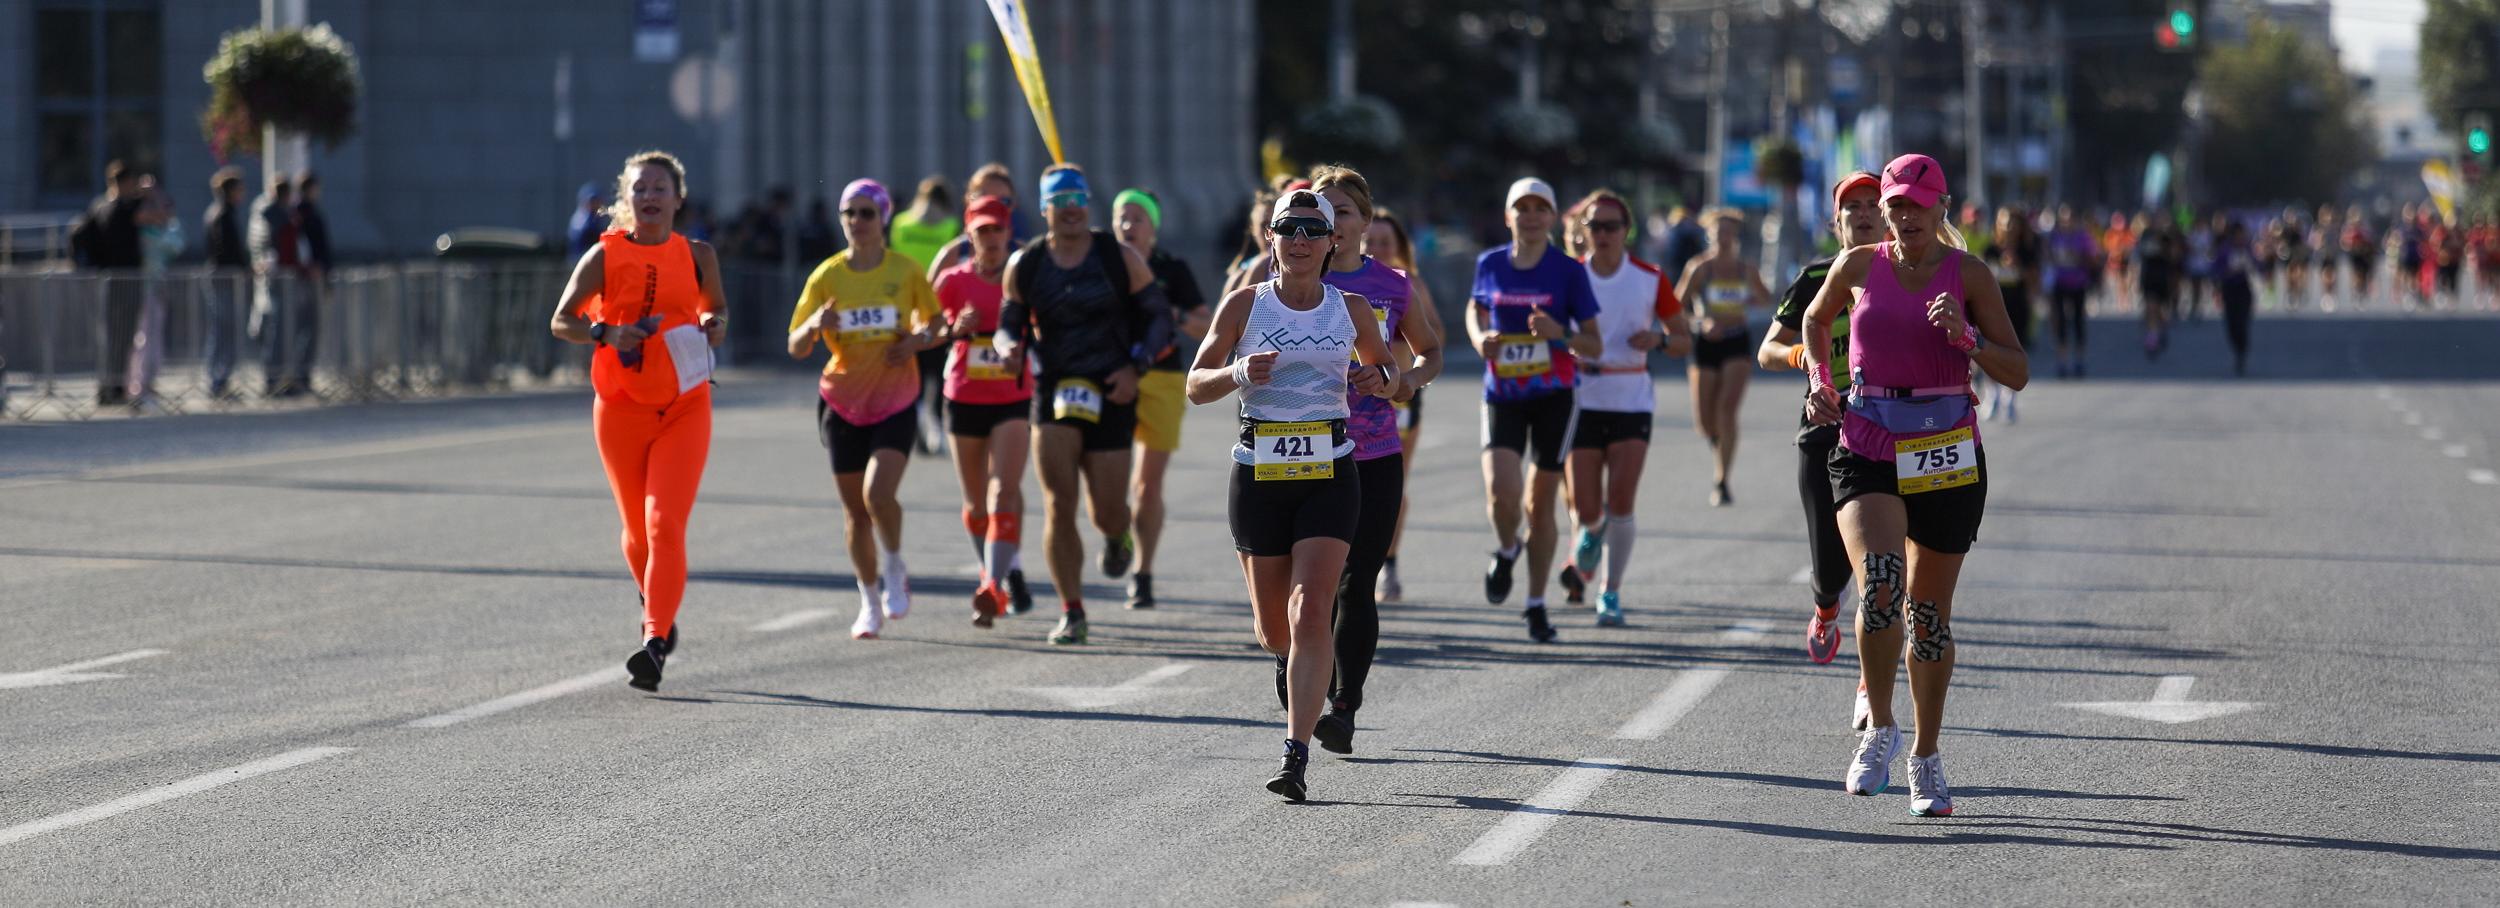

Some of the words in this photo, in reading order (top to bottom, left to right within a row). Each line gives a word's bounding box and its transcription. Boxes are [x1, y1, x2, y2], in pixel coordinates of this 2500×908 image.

[850, 308, 883, 327] 385
[1505, 344, 1535, 361] 677
[1273, 436, 1314, 457] 421
[1914, 445, 1960, 471] 755
